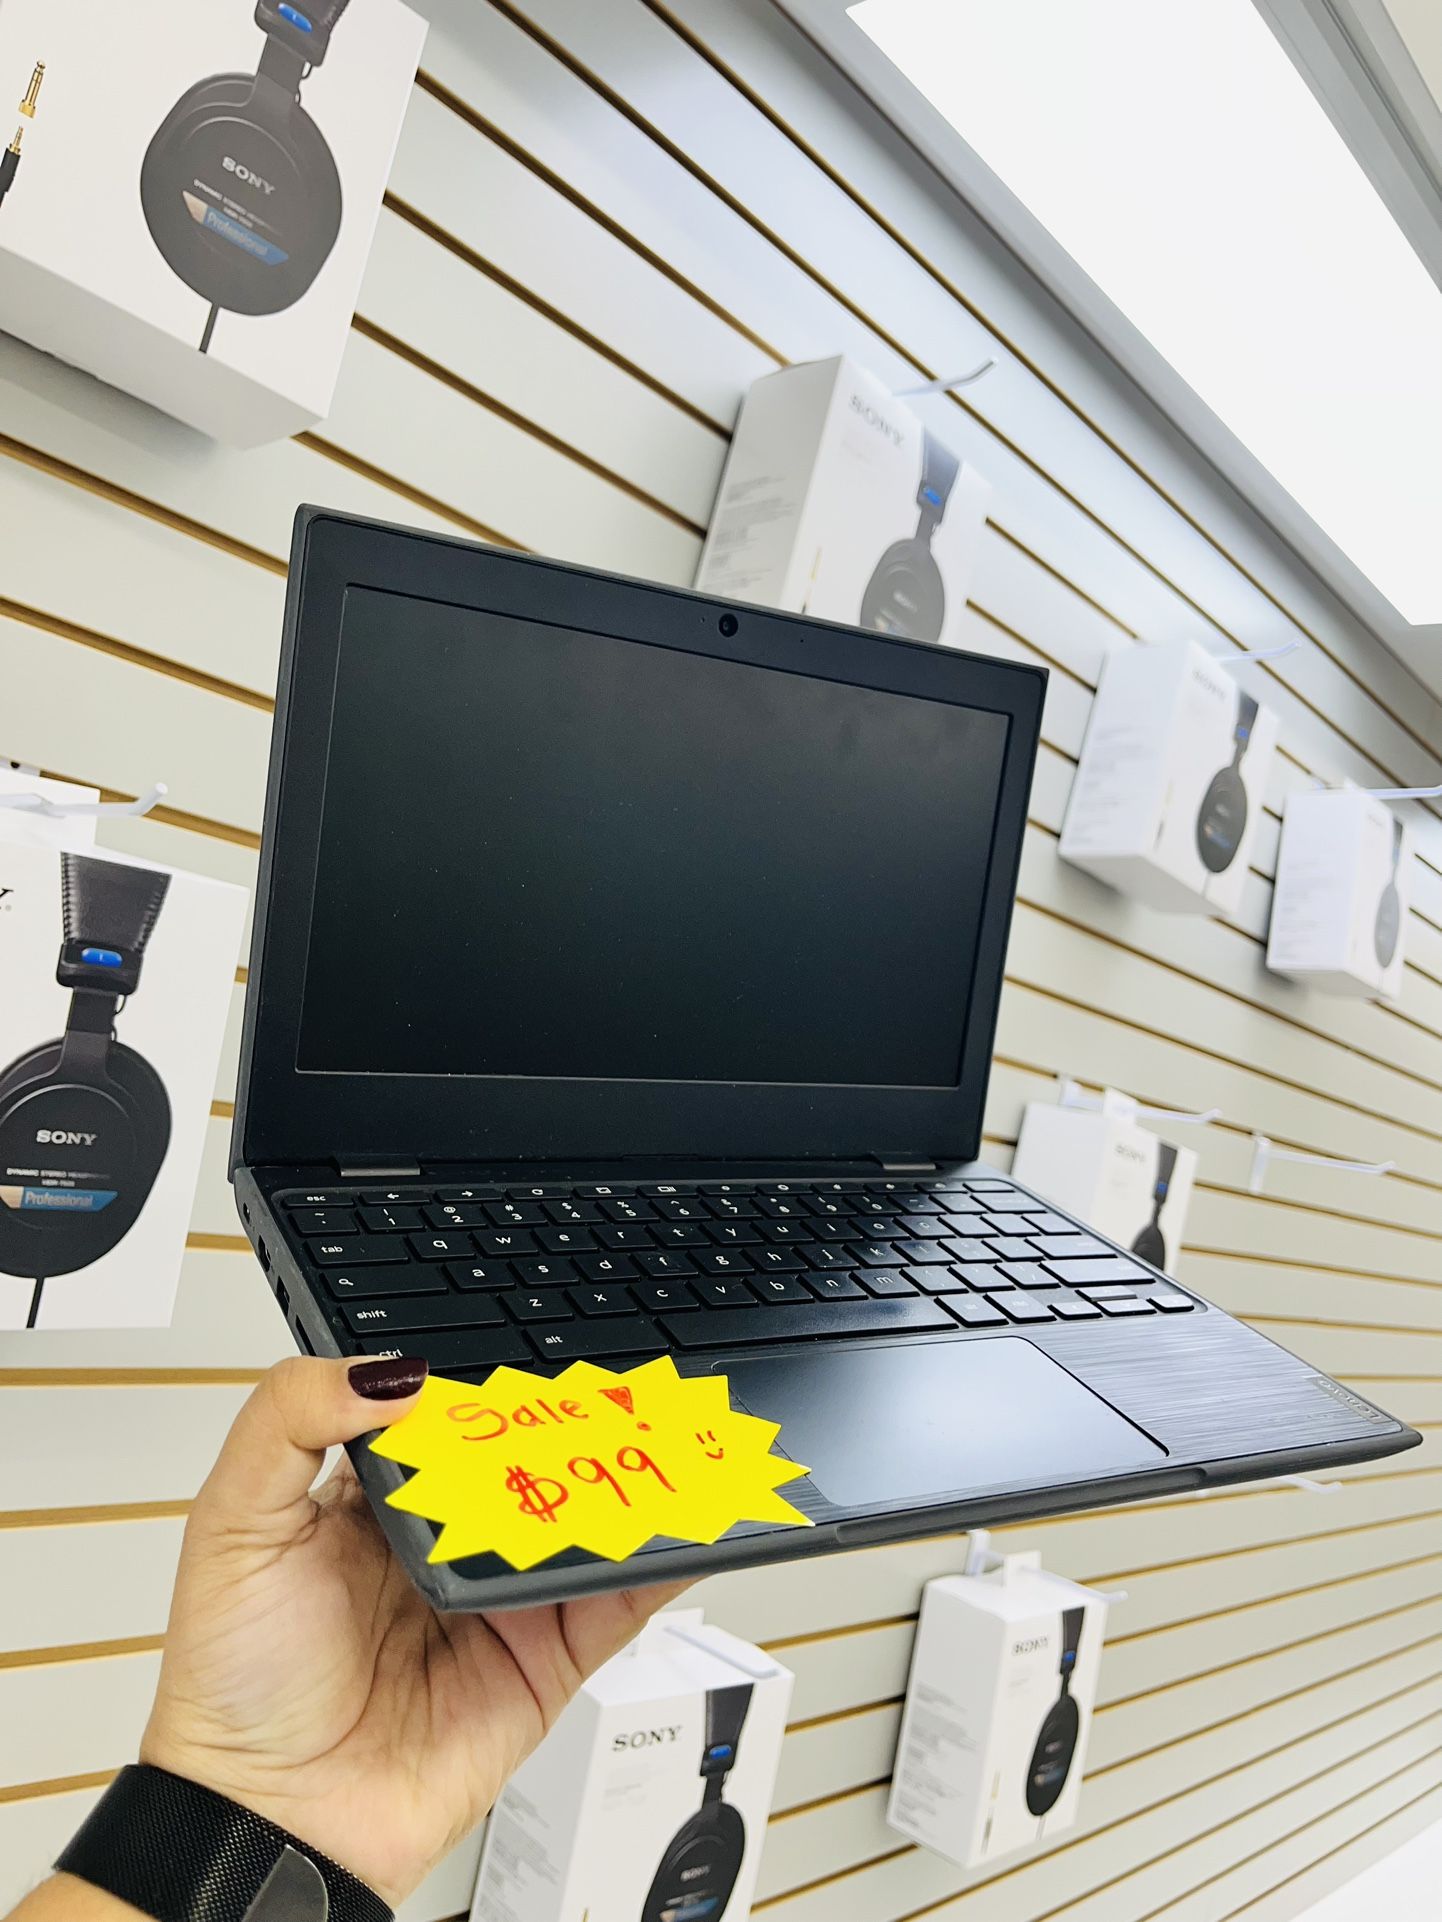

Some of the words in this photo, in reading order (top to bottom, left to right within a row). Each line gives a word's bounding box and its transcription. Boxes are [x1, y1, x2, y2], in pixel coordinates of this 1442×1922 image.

[222, 156, 276, 195] SONY
[36, 1129, 97, 1146] SONY
[25, 1190, 94, 1207] Professional
[388, 1217, 396, 1225] 1
[451, 1215, 464, 1223] 2
[511, 1213, 523, 1221] 3
[625, 1209, 637, 1217] 5
[679, 1208, 690, 1216] 6
[728, 1206, 738, 1214] 7
[320, 1245, 343, 1253] tab
[432, 1240, 448, 1250] q
[495, 1236, 511, 1244] w
[558, 1234, 570, 1242] e
[617, 1231, 625, 1239] r
[672, 1228, 685, 1237] t
[725, 1228, 737, 1237] y
[472, 1269, 486, 1277] a
[537, 1265, 549, 1273] s
[599, 1259, 613, 1270] d
[659, 1256, 668, 1266] f
[715, 1255, 730, 1265] g
[767, 1252, 782, 1261] h
[869, 1247, 885, 1257] k
[356, 1309, 388, 1319] shift
[529, 1298, 543, 1307] z
[593, 1293, 607, 1302] x
[656, 1289, 669, 1298] c
[715, 1286, 726, 1294] v
[769, 1281, 785, 1291] b
[825, 1279, 839, 1287] n
[875, 1276, 894, 1284] m
[544, 1335, 563, 1344] alt
[505, 1446, 677, 1523] $99
[611, 1725, 683, 1752] SONY
